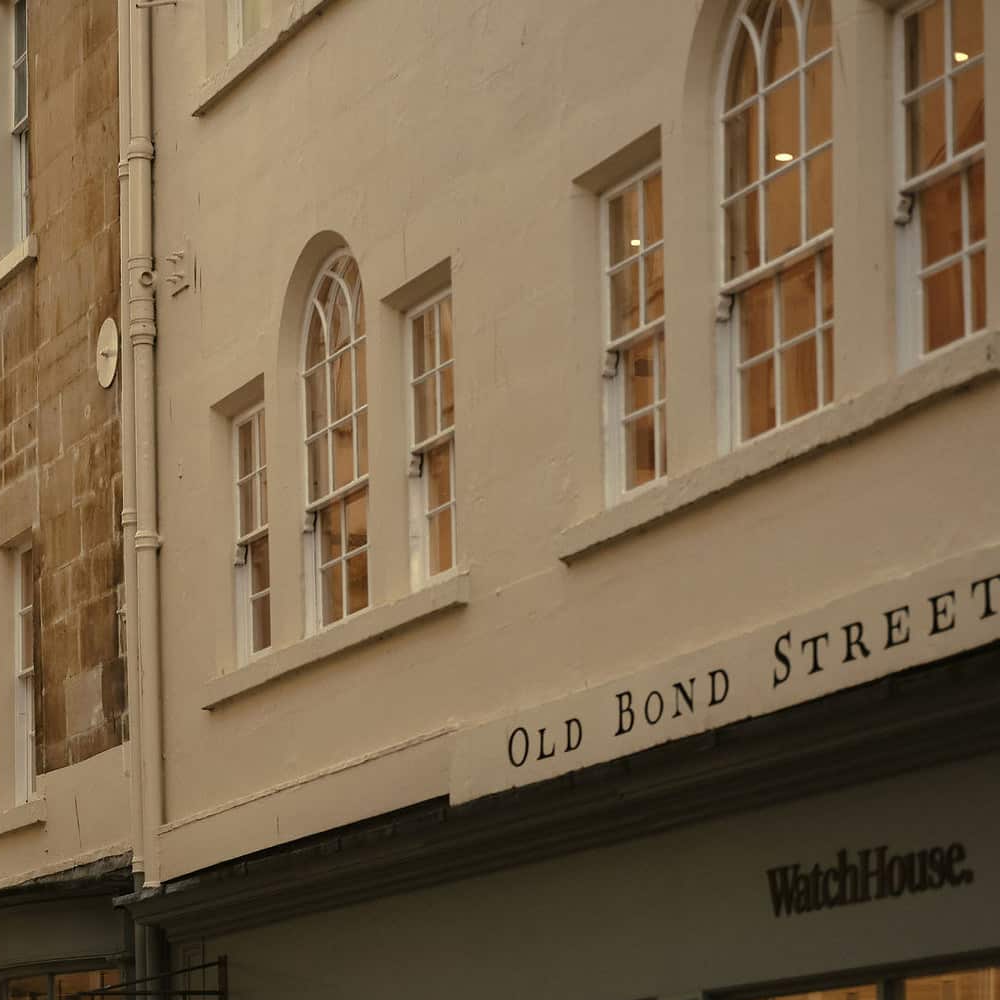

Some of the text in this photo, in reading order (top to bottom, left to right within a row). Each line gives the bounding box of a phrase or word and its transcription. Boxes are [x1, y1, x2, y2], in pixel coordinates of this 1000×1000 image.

[506, 573, 1000, 768] OLD BOND STREET
